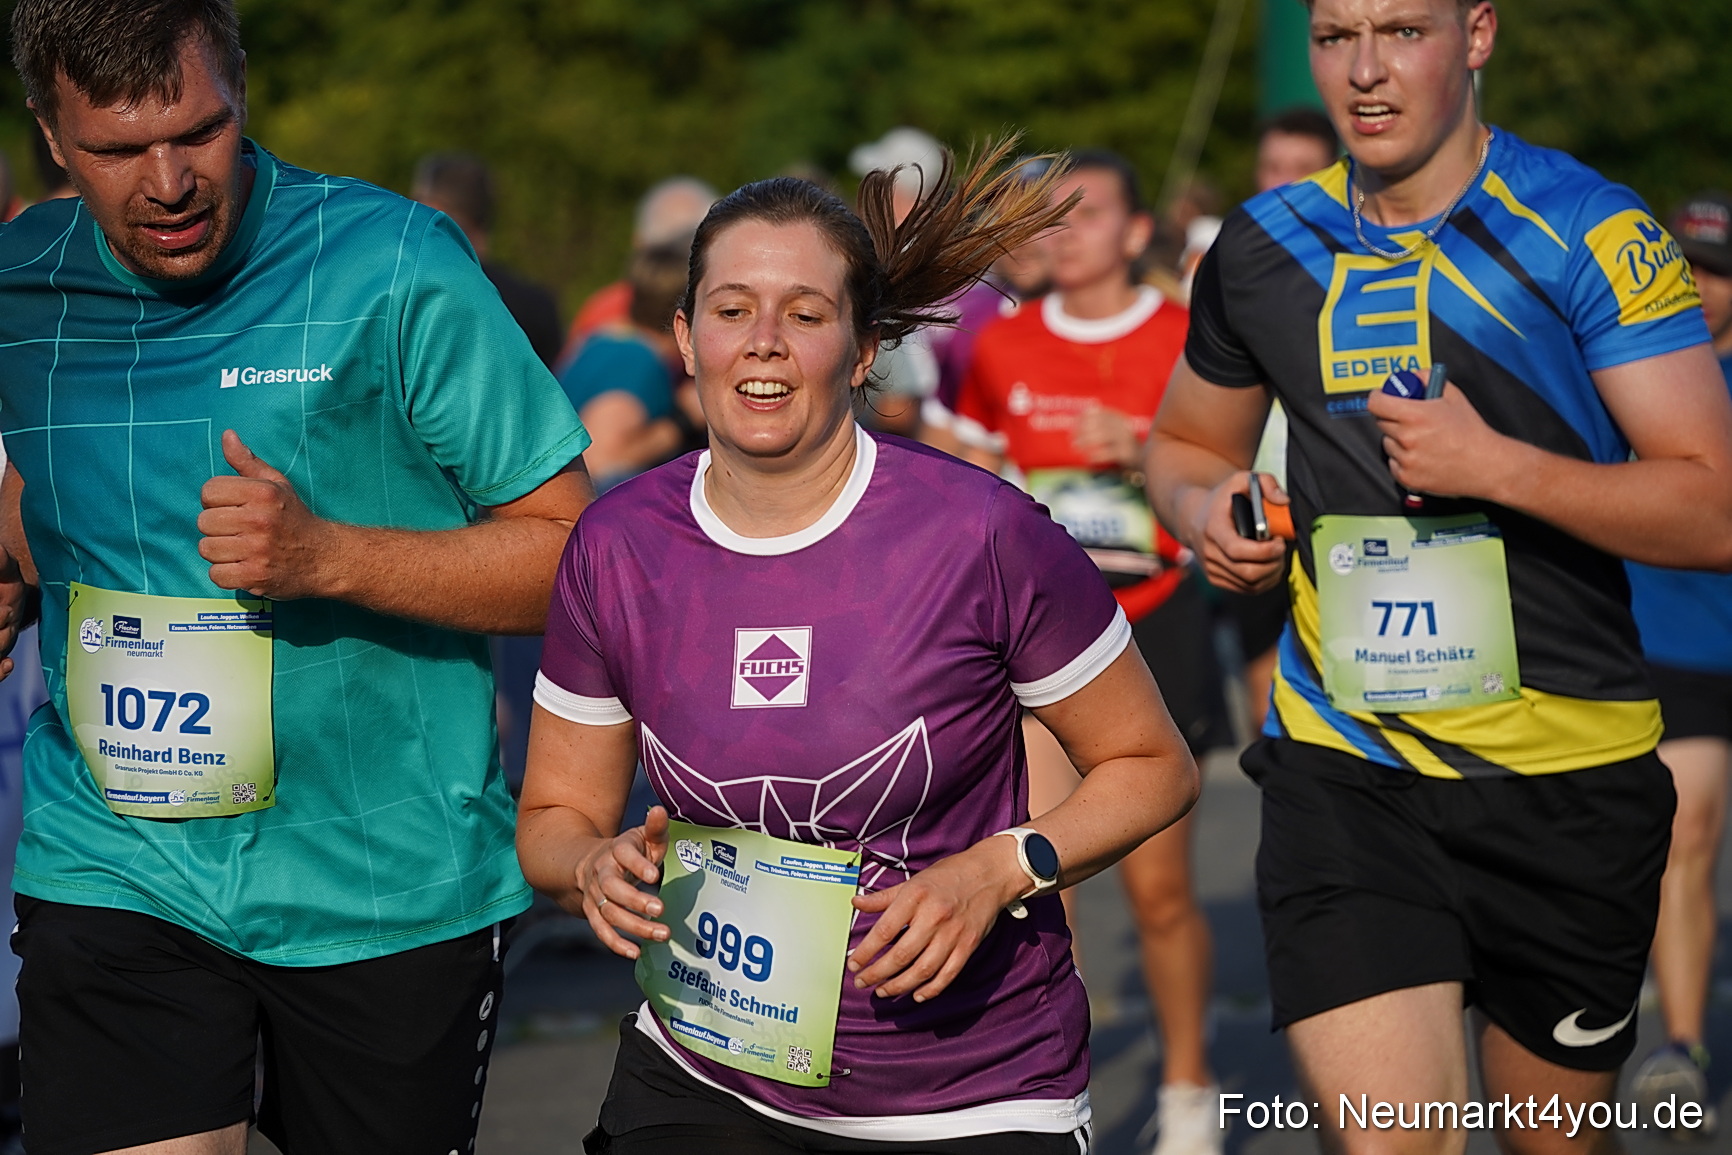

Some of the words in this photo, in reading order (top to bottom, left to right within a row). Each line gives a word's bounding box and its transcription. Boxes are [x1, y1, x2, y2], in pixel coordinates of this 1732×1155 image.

[241, 363, 333, 385] Grasruck
[1332, 355, 1421, 379] EDEKA
[1371, 600, 1438, 637] 771
[105, 636, 164, 650] Firmenlauf
[127, 650, 163, 658] neumarkt
[1355, 647, 1411, 664] Manuel
[1415, 646, 1475, 664] Schätz
[739, 660, 805, 675] FUCHS
[101, 683, 212, 735] 1072
[98, 738, 172, 763] Reinhard
[178, 747, 226, 766] Benz
[114, 764, 138, 773] Grasruck
[138, 767, 159, 775] Projekt
[159, 768, 177, 776] GmbH
[106, 790, 166, 804] firmenlauf.bayern
[704, 858, 751, 886] Firmenlauf
[720, 878, 747, 894] neumarkt
[695, 911, 774, 983] 999
[668, 960, 727, 1002] Stefanie
[729, 988, 799, 1024] Schmid
[672, 1020, 726, 1047] firmenlauf.bayern
[743, 1047, 776, 1060] Firmenlauf
